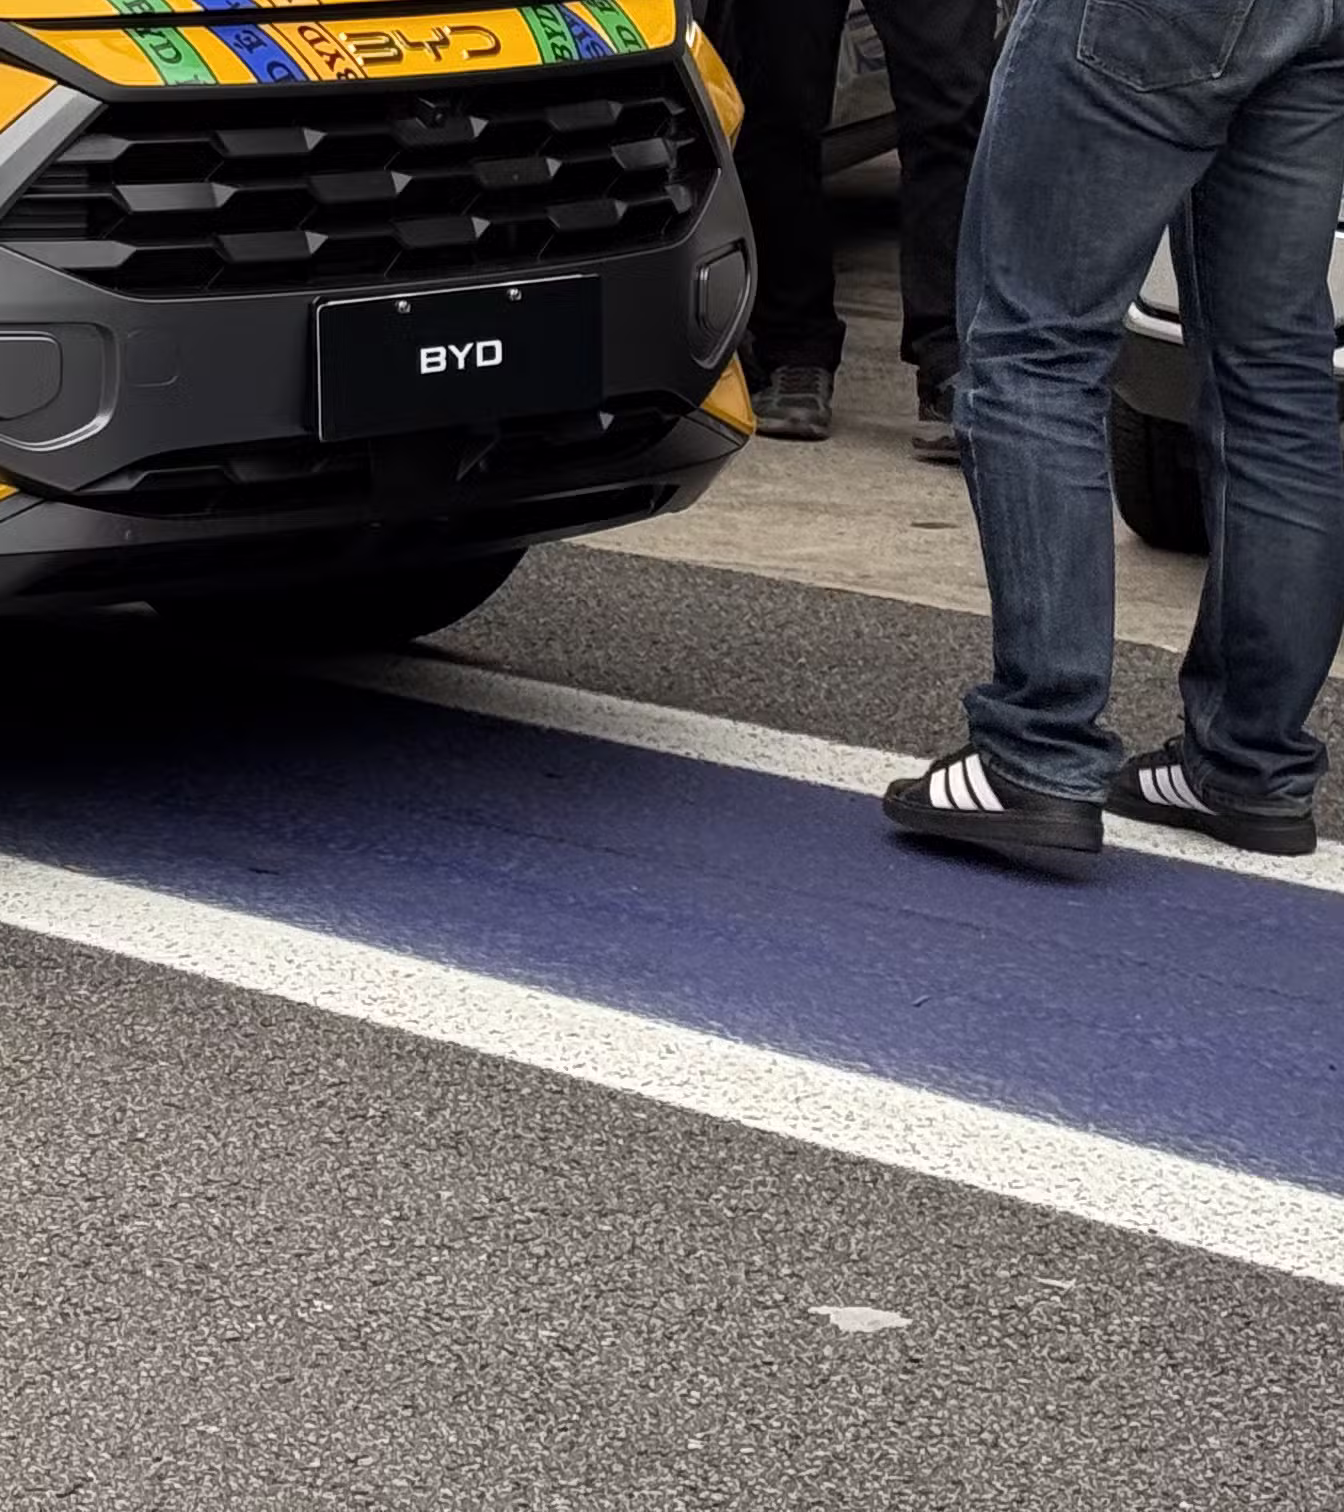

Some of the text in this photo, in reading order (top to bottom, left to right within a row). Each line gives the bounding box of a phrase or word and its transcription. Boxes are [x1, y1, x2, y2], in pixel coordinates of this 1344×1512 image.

[339, 25, 501, 66] BYD
[532, 4, 572, 61] BYD
[419, 340, 503, 374] BYD
